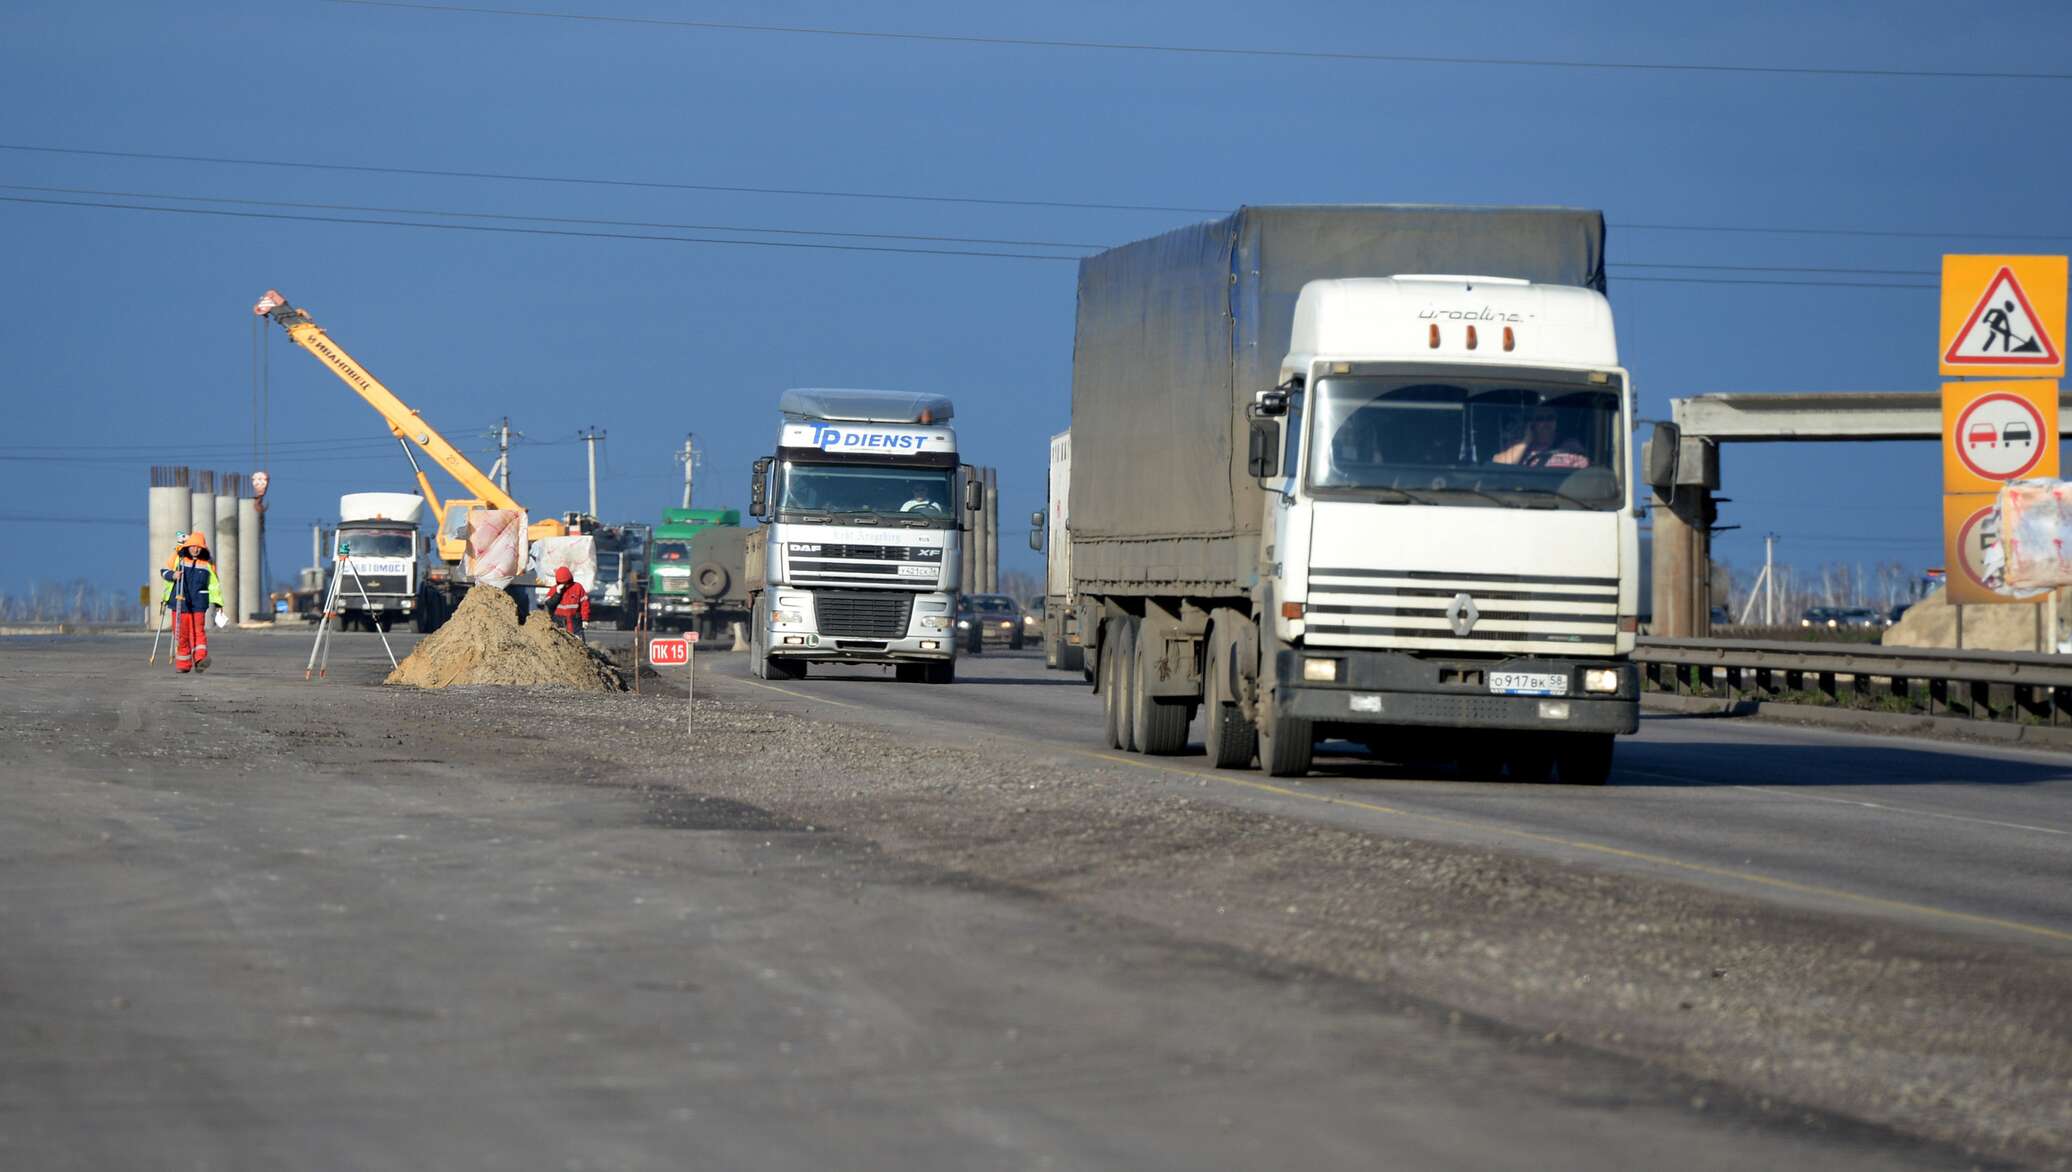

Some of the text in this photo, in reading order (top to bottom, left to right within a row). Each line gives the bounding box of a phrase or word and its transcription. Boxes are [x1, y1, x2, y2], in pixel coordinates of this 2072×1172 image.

[810, 421, 928, 453] TP DIENST
[790, 544, 821, 552] DAF
[652, 644, 684, 659] ПК 15
[1550, 675, 1563, 686] 58
